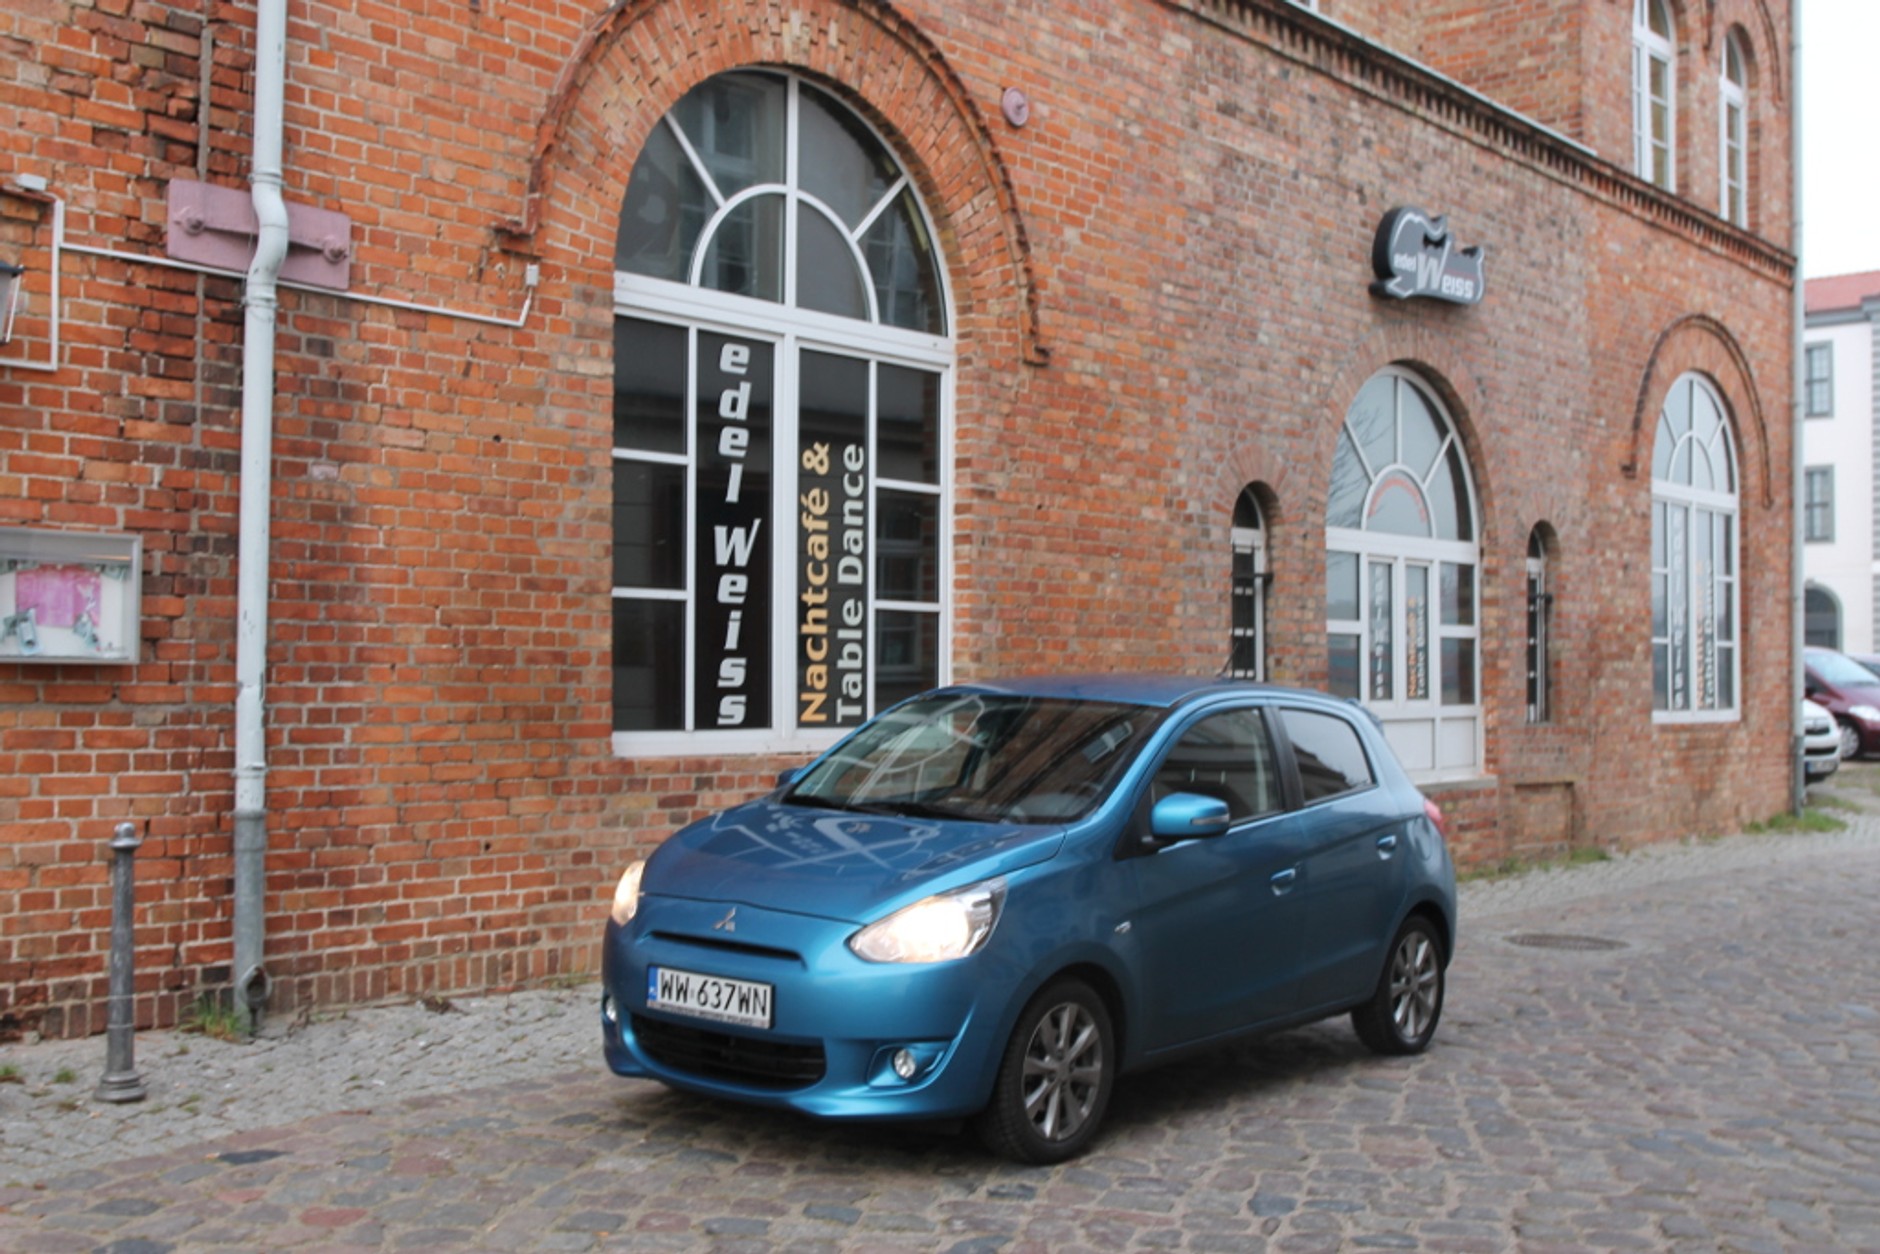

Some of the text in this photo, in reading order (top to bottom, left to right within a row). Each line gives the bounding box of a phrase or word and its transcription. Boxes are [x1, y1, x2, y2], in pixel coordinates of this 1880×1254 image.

[800, 440, 830, 723] Nachtcafé &
[837, 443, 865, 722] Table Dance
[660, 971, 690, 1003] WW
[697, 979, 767, 1017] 637WN
